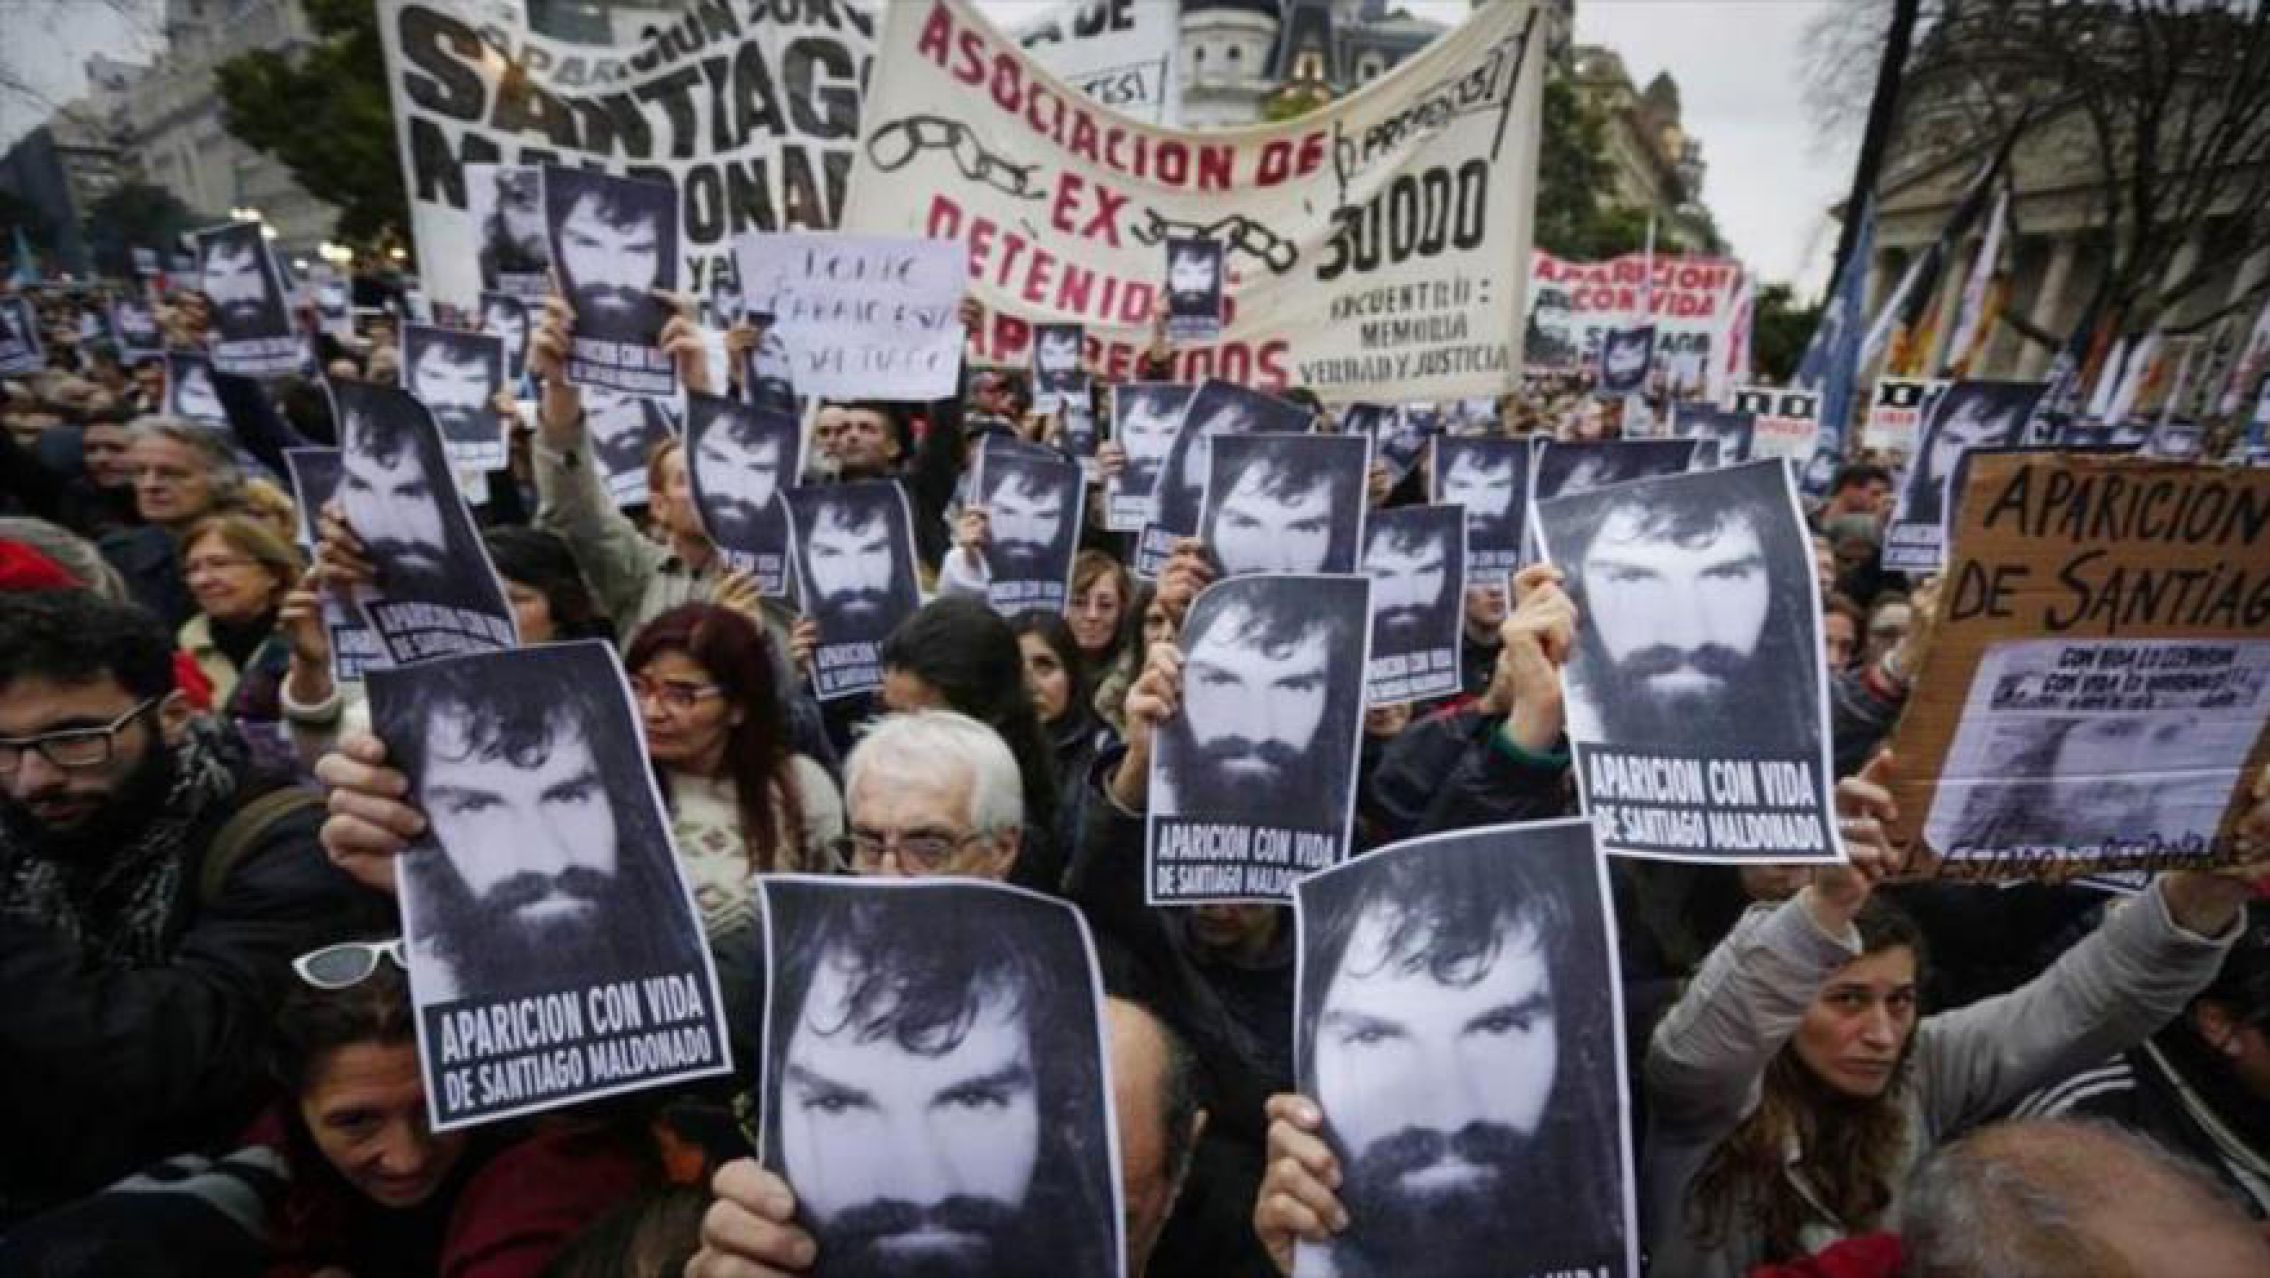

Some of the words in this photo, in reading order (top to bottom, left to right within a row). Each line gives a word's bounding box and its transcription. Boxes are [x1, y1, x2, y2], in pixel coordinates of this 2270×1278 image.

[402, 5, 874, 159] SANTIAG
[917, 3, 1233, 191] ASOCIACION
[1256, 130, 1327, 187] DE
[1053, 172, 1130, 249] EX
[927, 195, 1241, 326] DETENID
[1361, 311, 1467, 347] MEMORIA
[1413, 345, 1508, 379] JUSTICIA
[1984, 464, 2270, 544] APARICION
[1949, 560, 2030, 622] DE
[1591, 753, 1705, 804] APARICION
[1708, 758, 1758, 806] CON
[1758, 761, 1816, 807] VIDA
[1158, 823, 1250, 861] APARICION
[1254, 827, 1292, 864] CON
[1294, 833, 1335, 869] VIDA
[1594, 805, 1621, 842] DE
[1621, 806, 1706, 849] SANTIAGO
[1709, 811, 1825, 850] MALDONADO
[1157, 865, 1177, 895] DE
[1178, 865, 1243, 895] SANTIAGO
[441, 990, 584, 1064] APARICION
[588, 979, 643, 1035] CON
[642, 972, 705, 1025] VIDA
[445, 1067, 476, 1113] DE
[478, 1048, 586, 1106] SANTIAGO
[588, 1024, 714, 1084] MALDONADO
